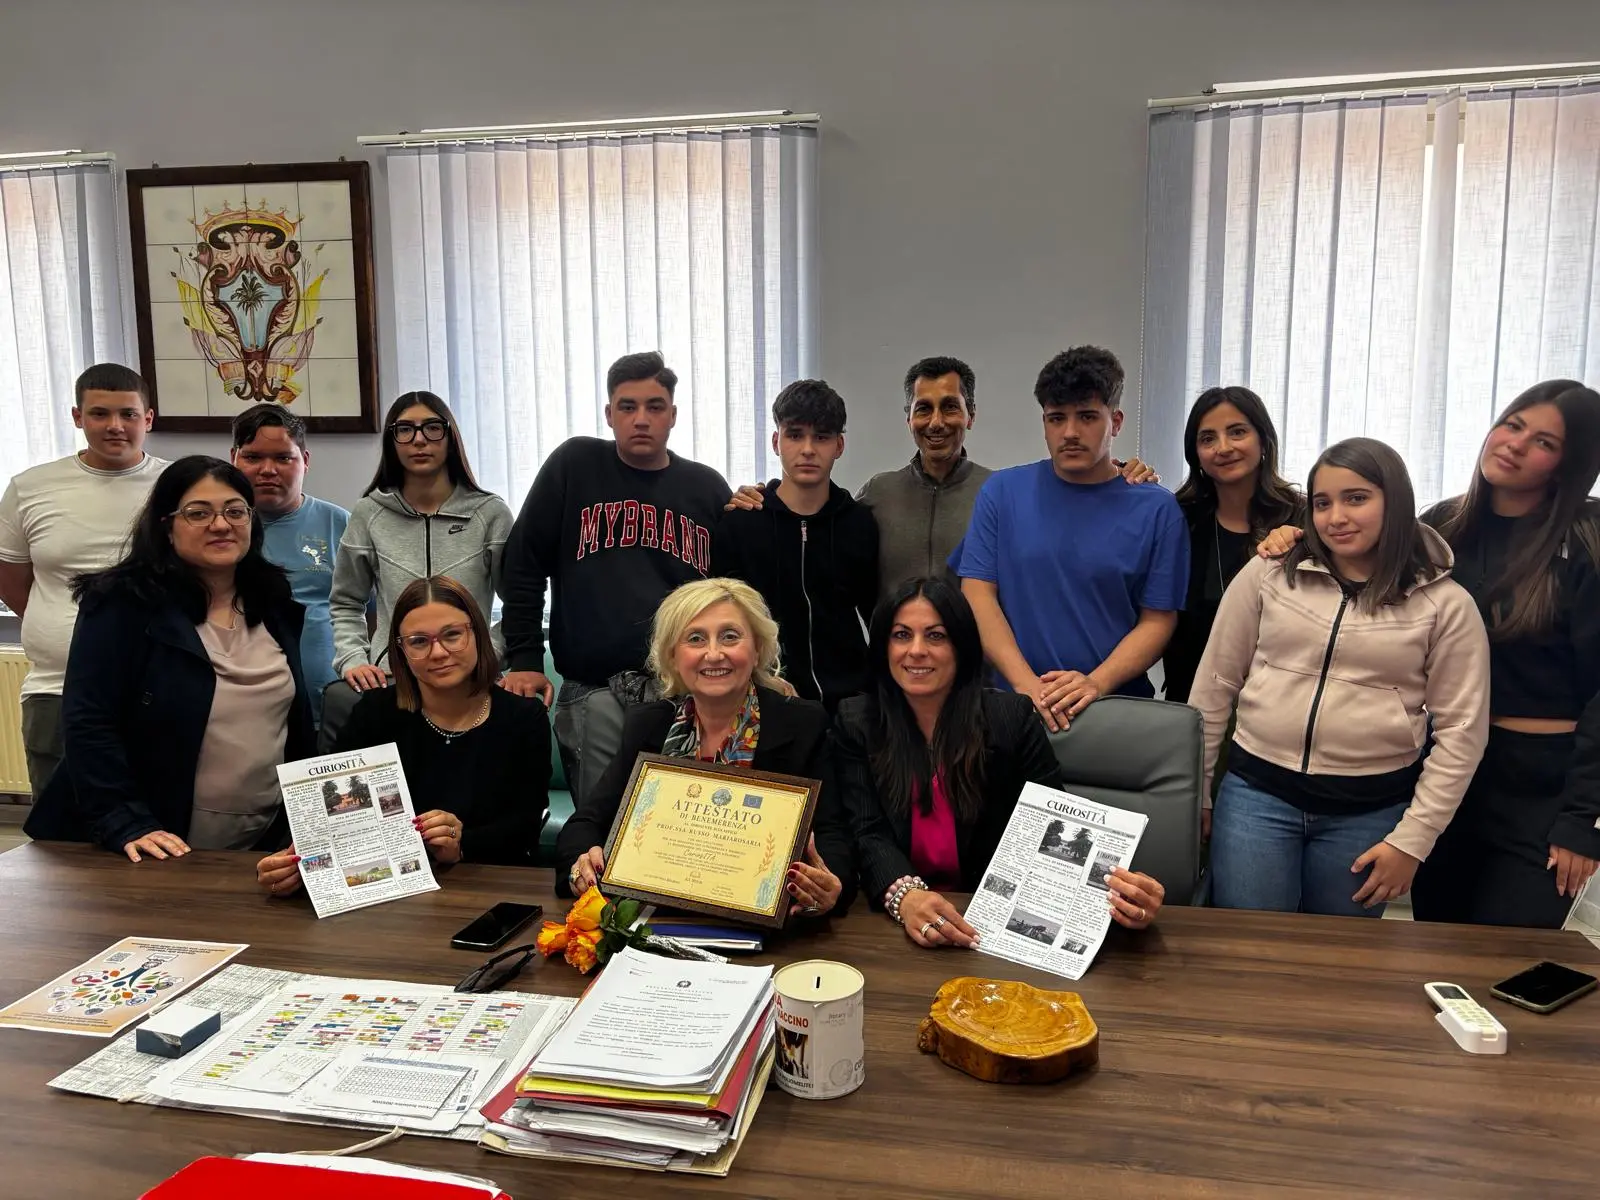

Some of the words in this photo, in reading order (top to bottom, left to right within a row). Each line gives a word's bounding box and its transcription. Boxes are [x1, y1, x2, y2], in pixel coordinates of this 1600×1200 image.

[577, 499, 711, 579] MYBRAND
[672, 799, 762, 825] ATTESTATO
[691, 813, 747, 831] BENEMERENZA
[776, 1009, 809, 1028] VACCINO
